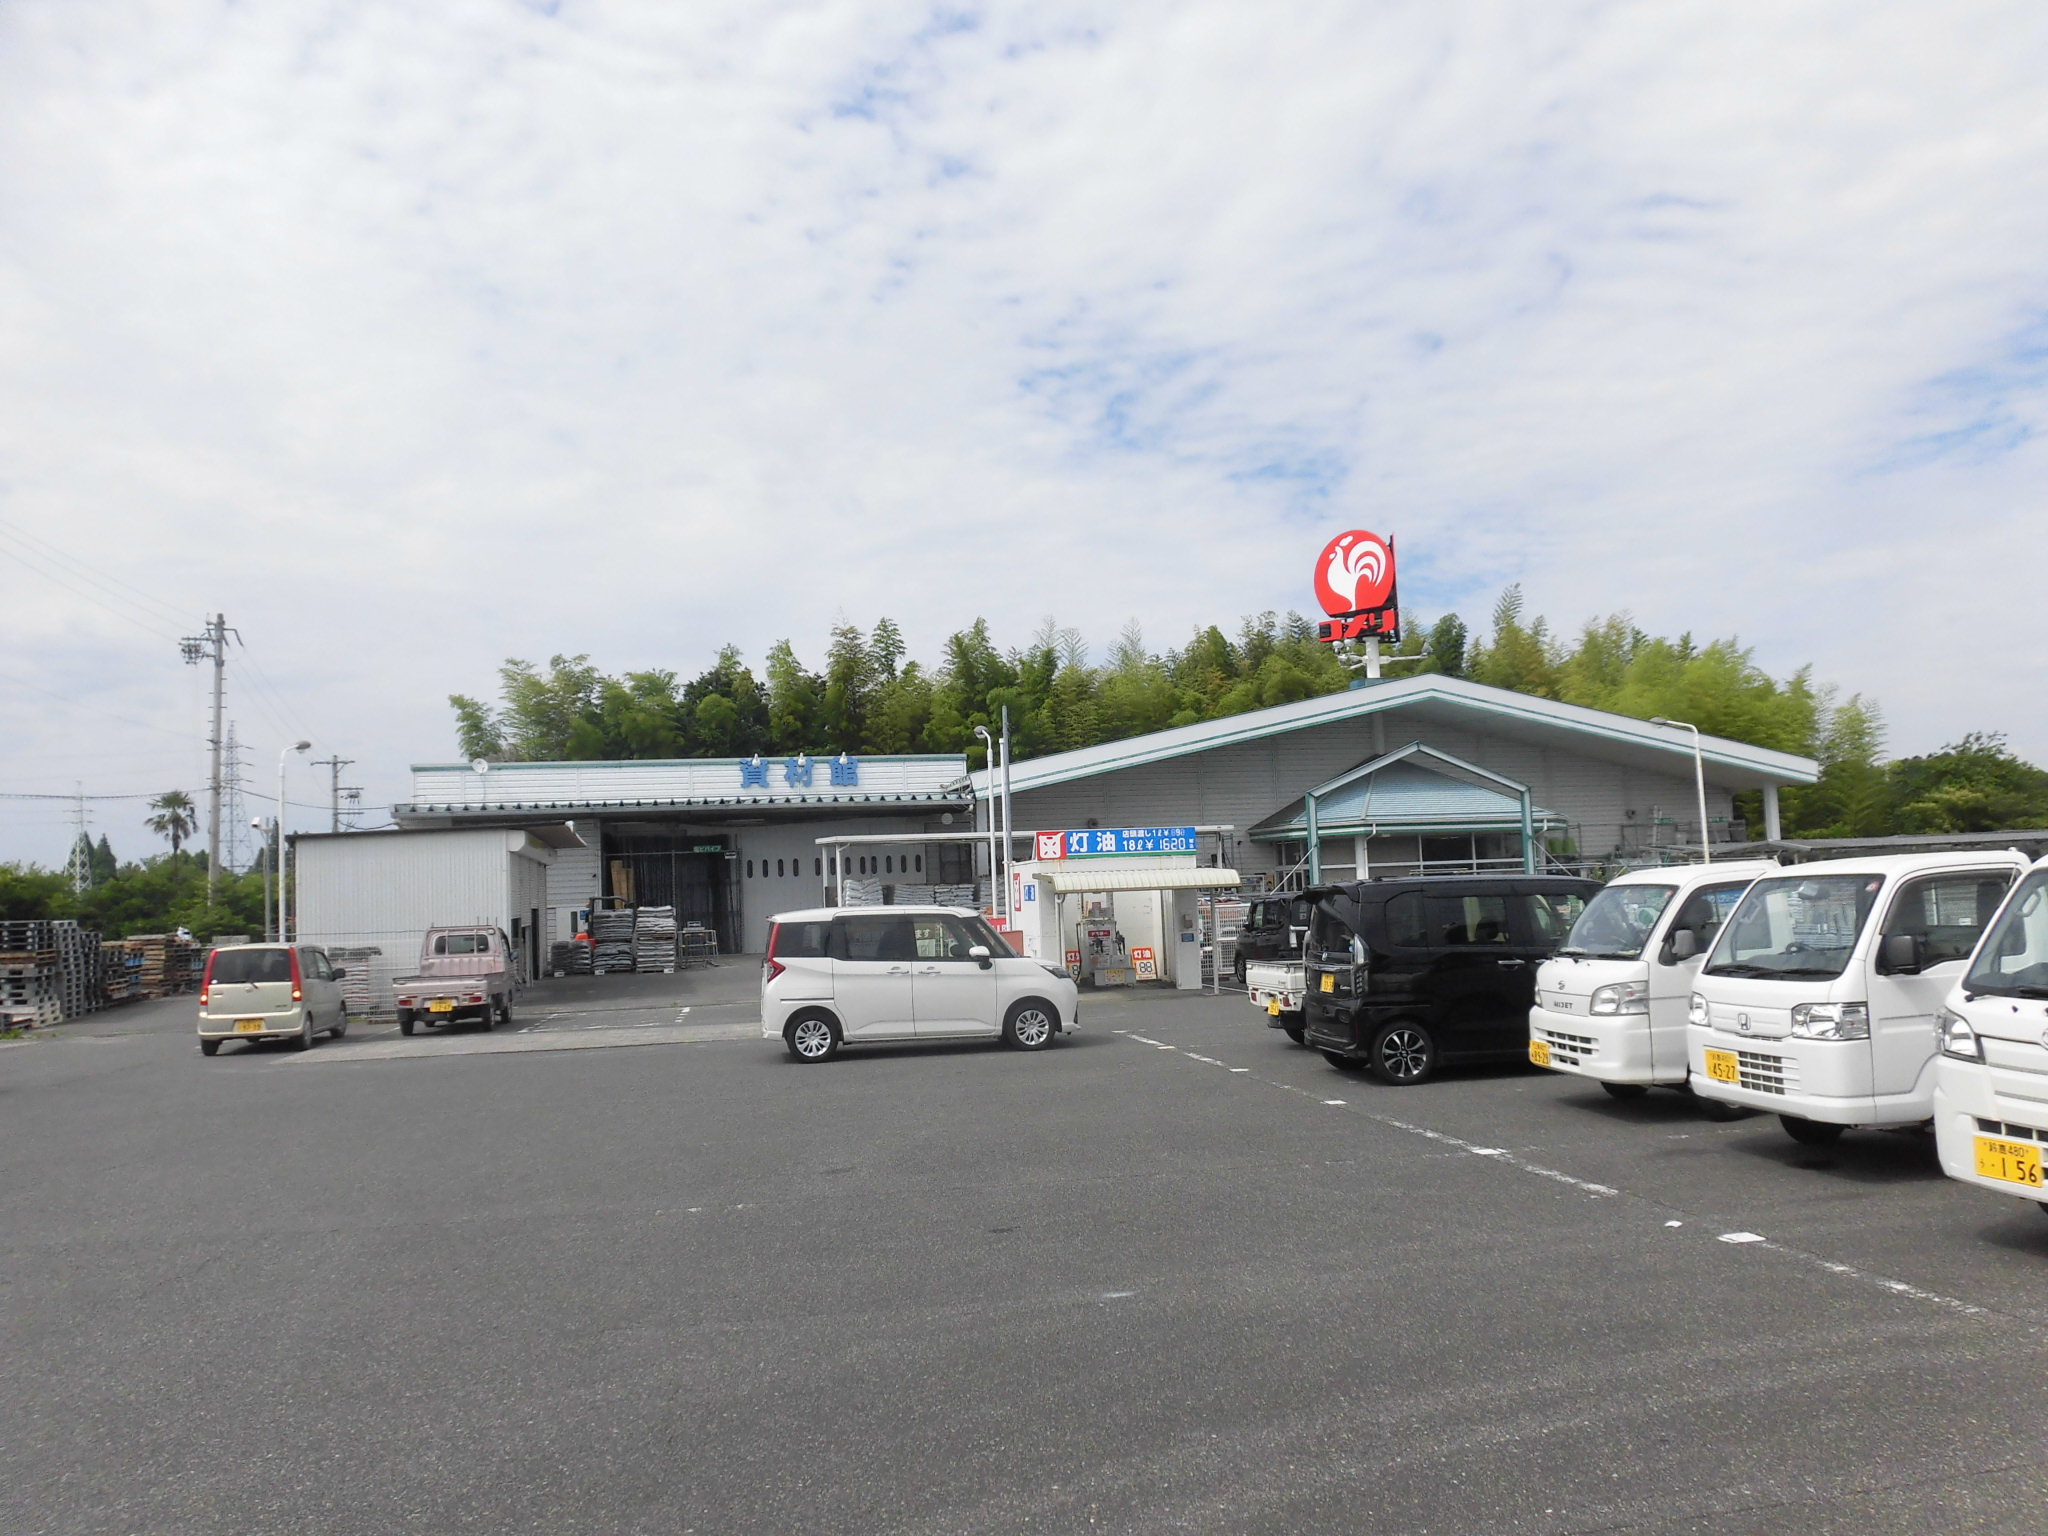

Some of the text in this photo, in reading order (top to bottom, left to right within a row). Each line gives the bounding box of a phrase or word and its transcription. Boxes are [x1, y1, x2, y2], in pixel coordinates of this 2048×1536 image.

[1319, 609, 1396, 642] コメリ
[740, 757, 858, 788] 資材館
[1069, 831, 1116, 853] 灯油
[1712, 1062, 1736, 1081] 45-27
[1988, 1141, 2026, 1158] 鈴鹿480
